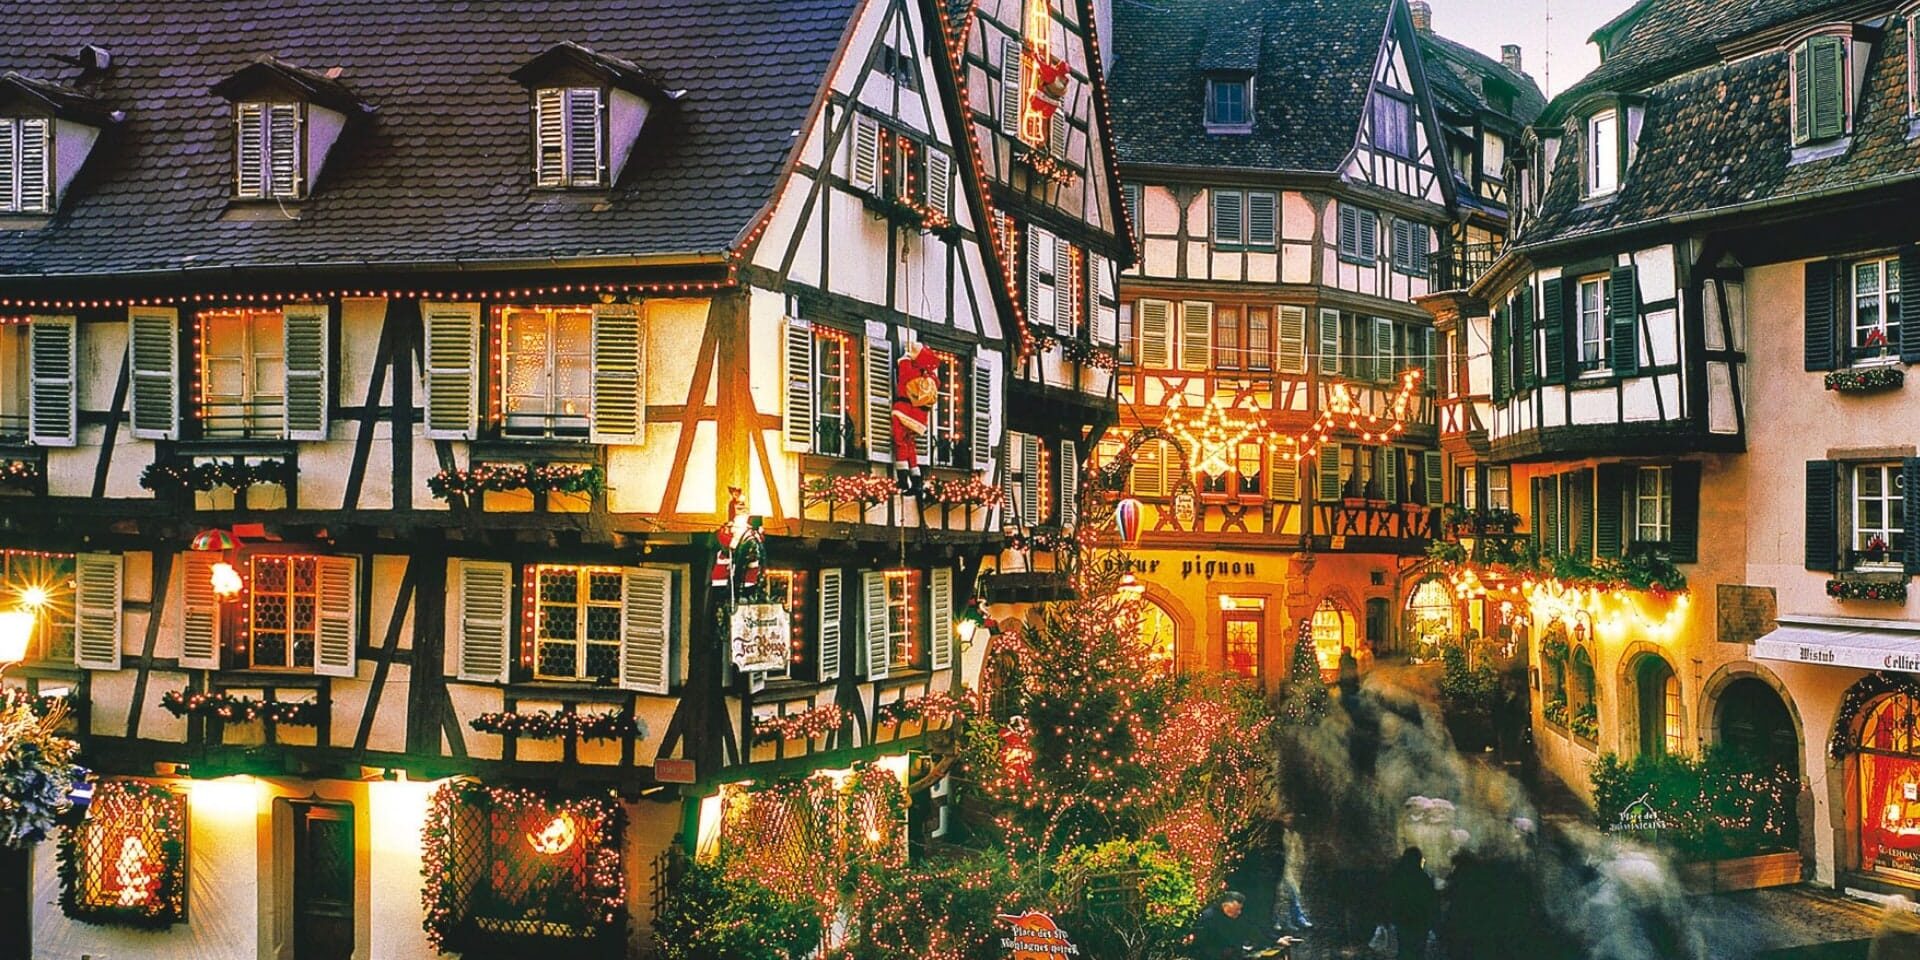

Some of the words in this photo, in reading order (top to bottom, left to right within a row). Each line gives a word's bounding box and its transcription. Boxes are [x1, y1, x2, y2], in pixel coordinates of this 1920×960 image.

[1181, 554, 1255, 579] pignon
[733, 636, 756, 658] Fer
[1799, 646, 1835, 662] Wistub
[1884, 655, 1920, 671] Cellier
[1888, 847, 1920, 860] LEHMAN
[1011, 925, 1035, 937] Place
[1037, 928, 1051, 938] des
[1000, 937, 1049, 952] Montagnes
[1051, 944, 1080, 956] noires
